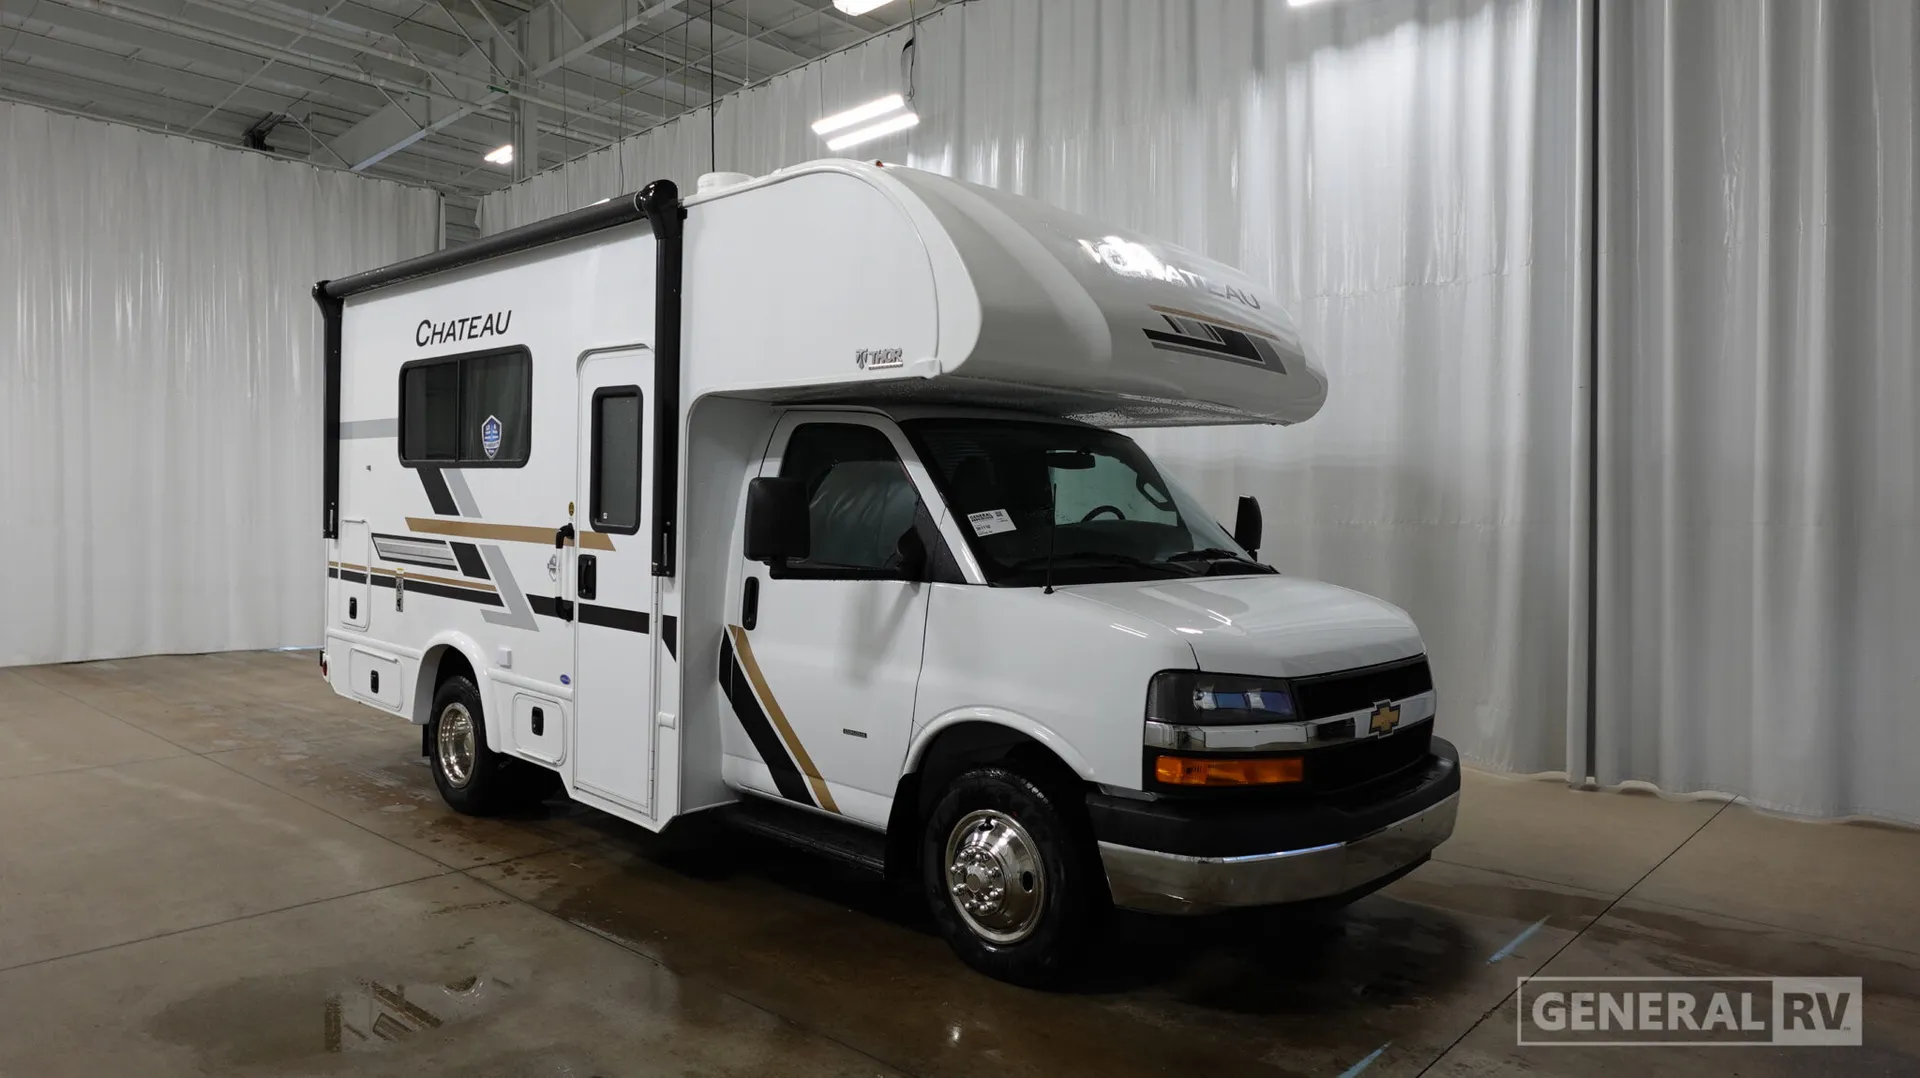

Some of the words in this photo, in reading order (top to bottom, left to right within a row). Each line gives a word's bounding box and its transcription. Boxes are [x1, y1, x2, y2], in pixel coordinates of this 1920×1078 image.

[1098, 241, 1261, 311] ATEAU
[415, 309, 512, 347] CHATEAU
[868, 348, 903, 365] THOR
